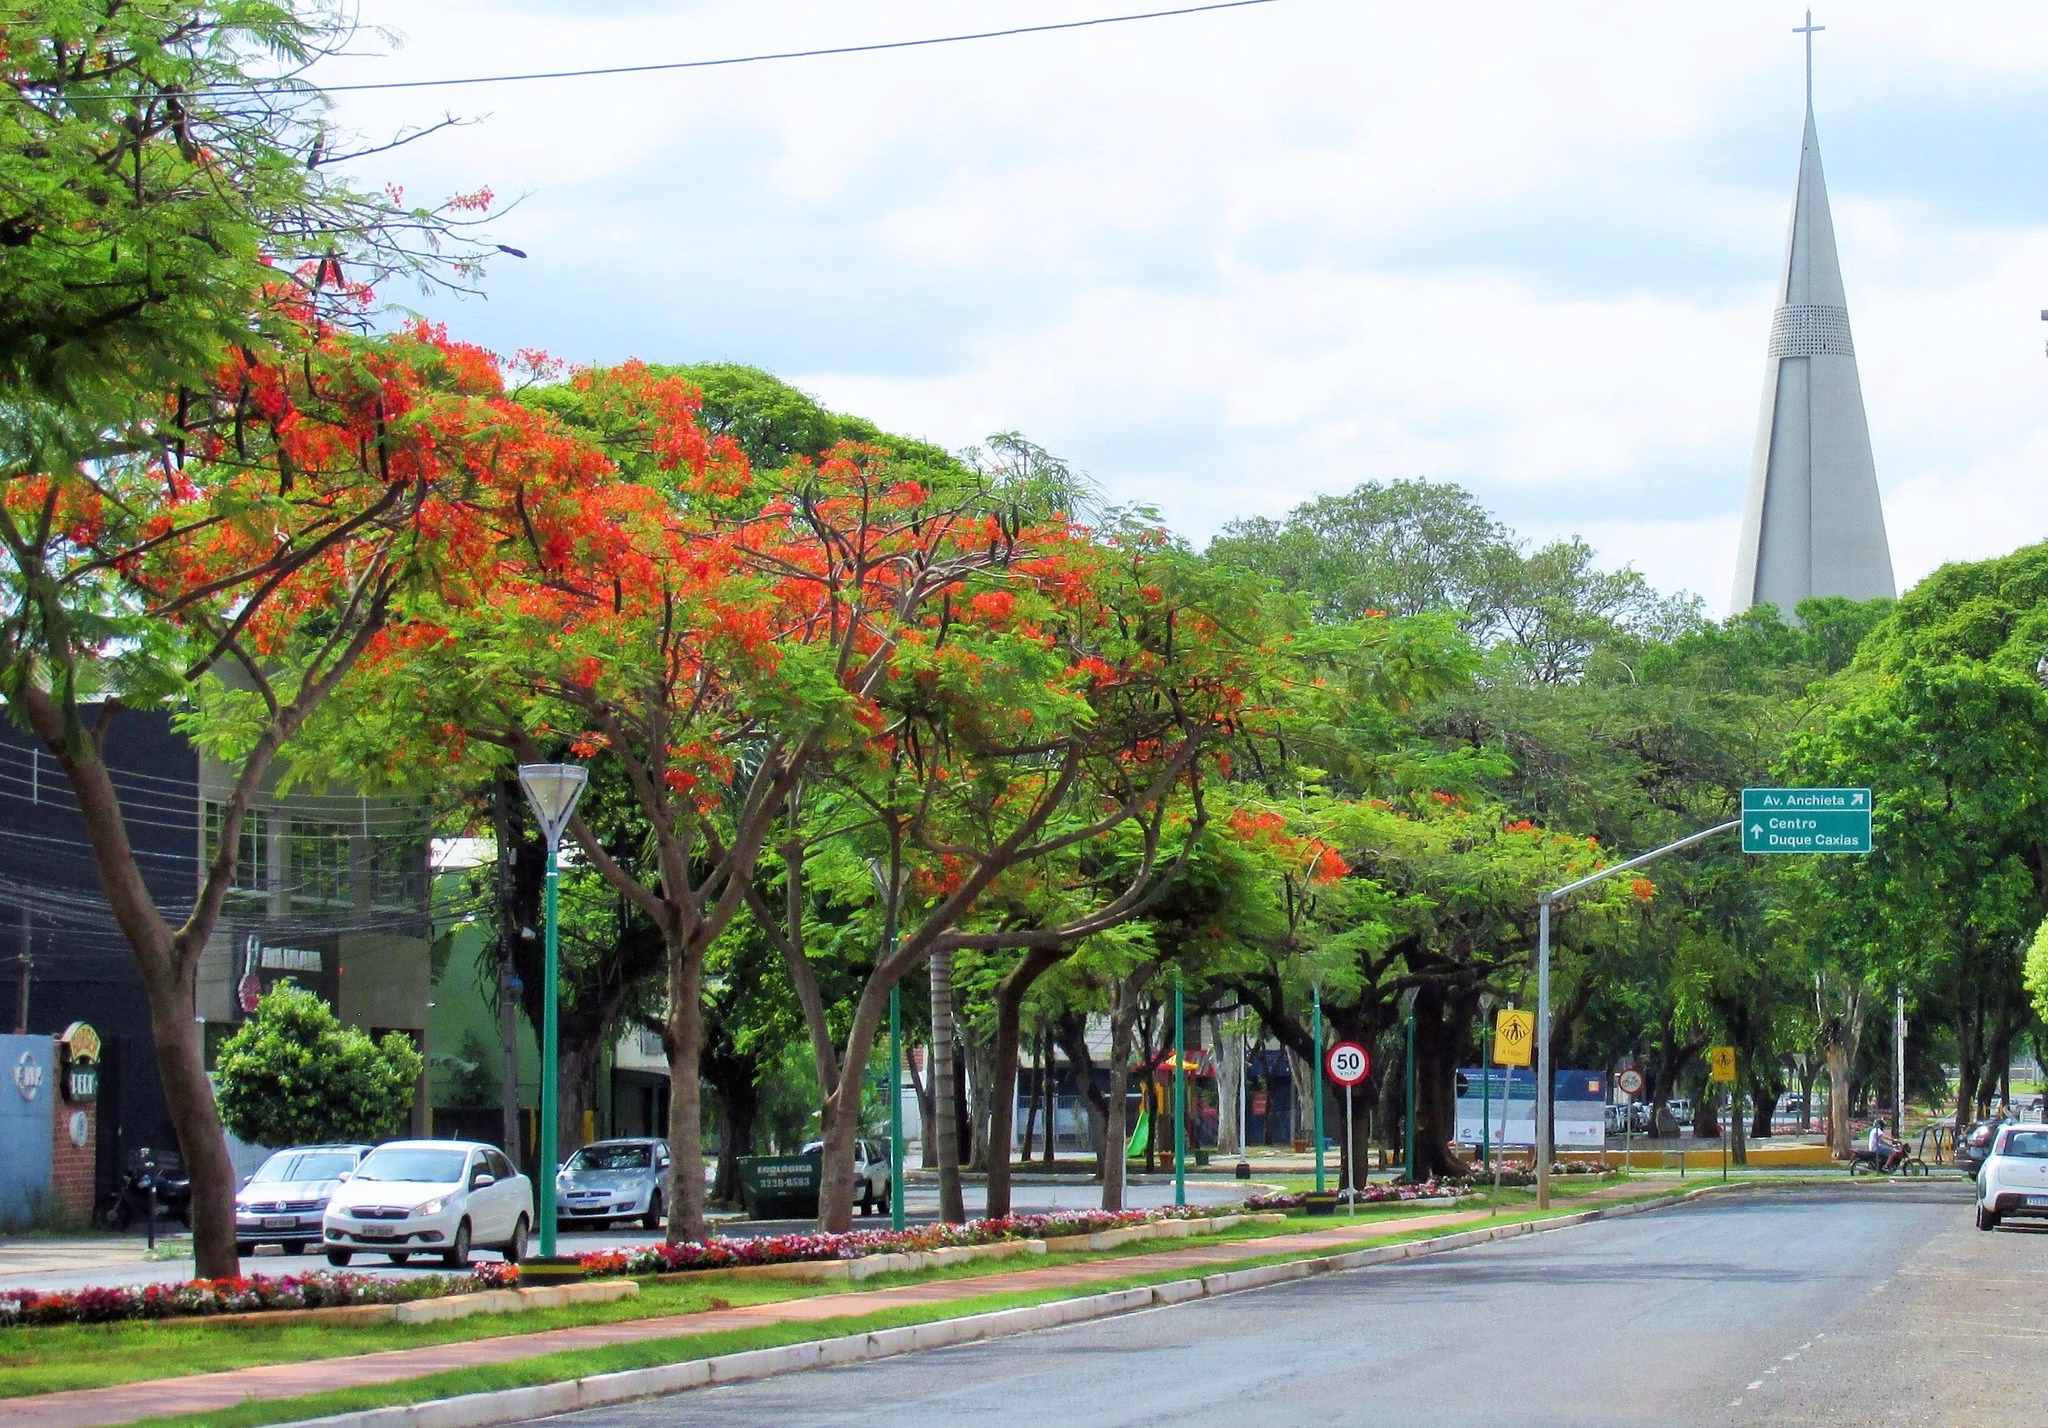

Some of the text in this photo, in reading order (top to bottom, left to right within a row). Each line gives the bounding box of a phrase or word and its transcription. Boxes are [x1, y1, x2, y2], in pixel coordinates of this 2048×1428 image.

[1763, 794, 1845, 806] Av. Anchieta
[1769, 817, 1817, 829] Centro
[1769, 834, 1859, 847] Duque Caxias
[1337, 1052, 1360, 1070] 50
